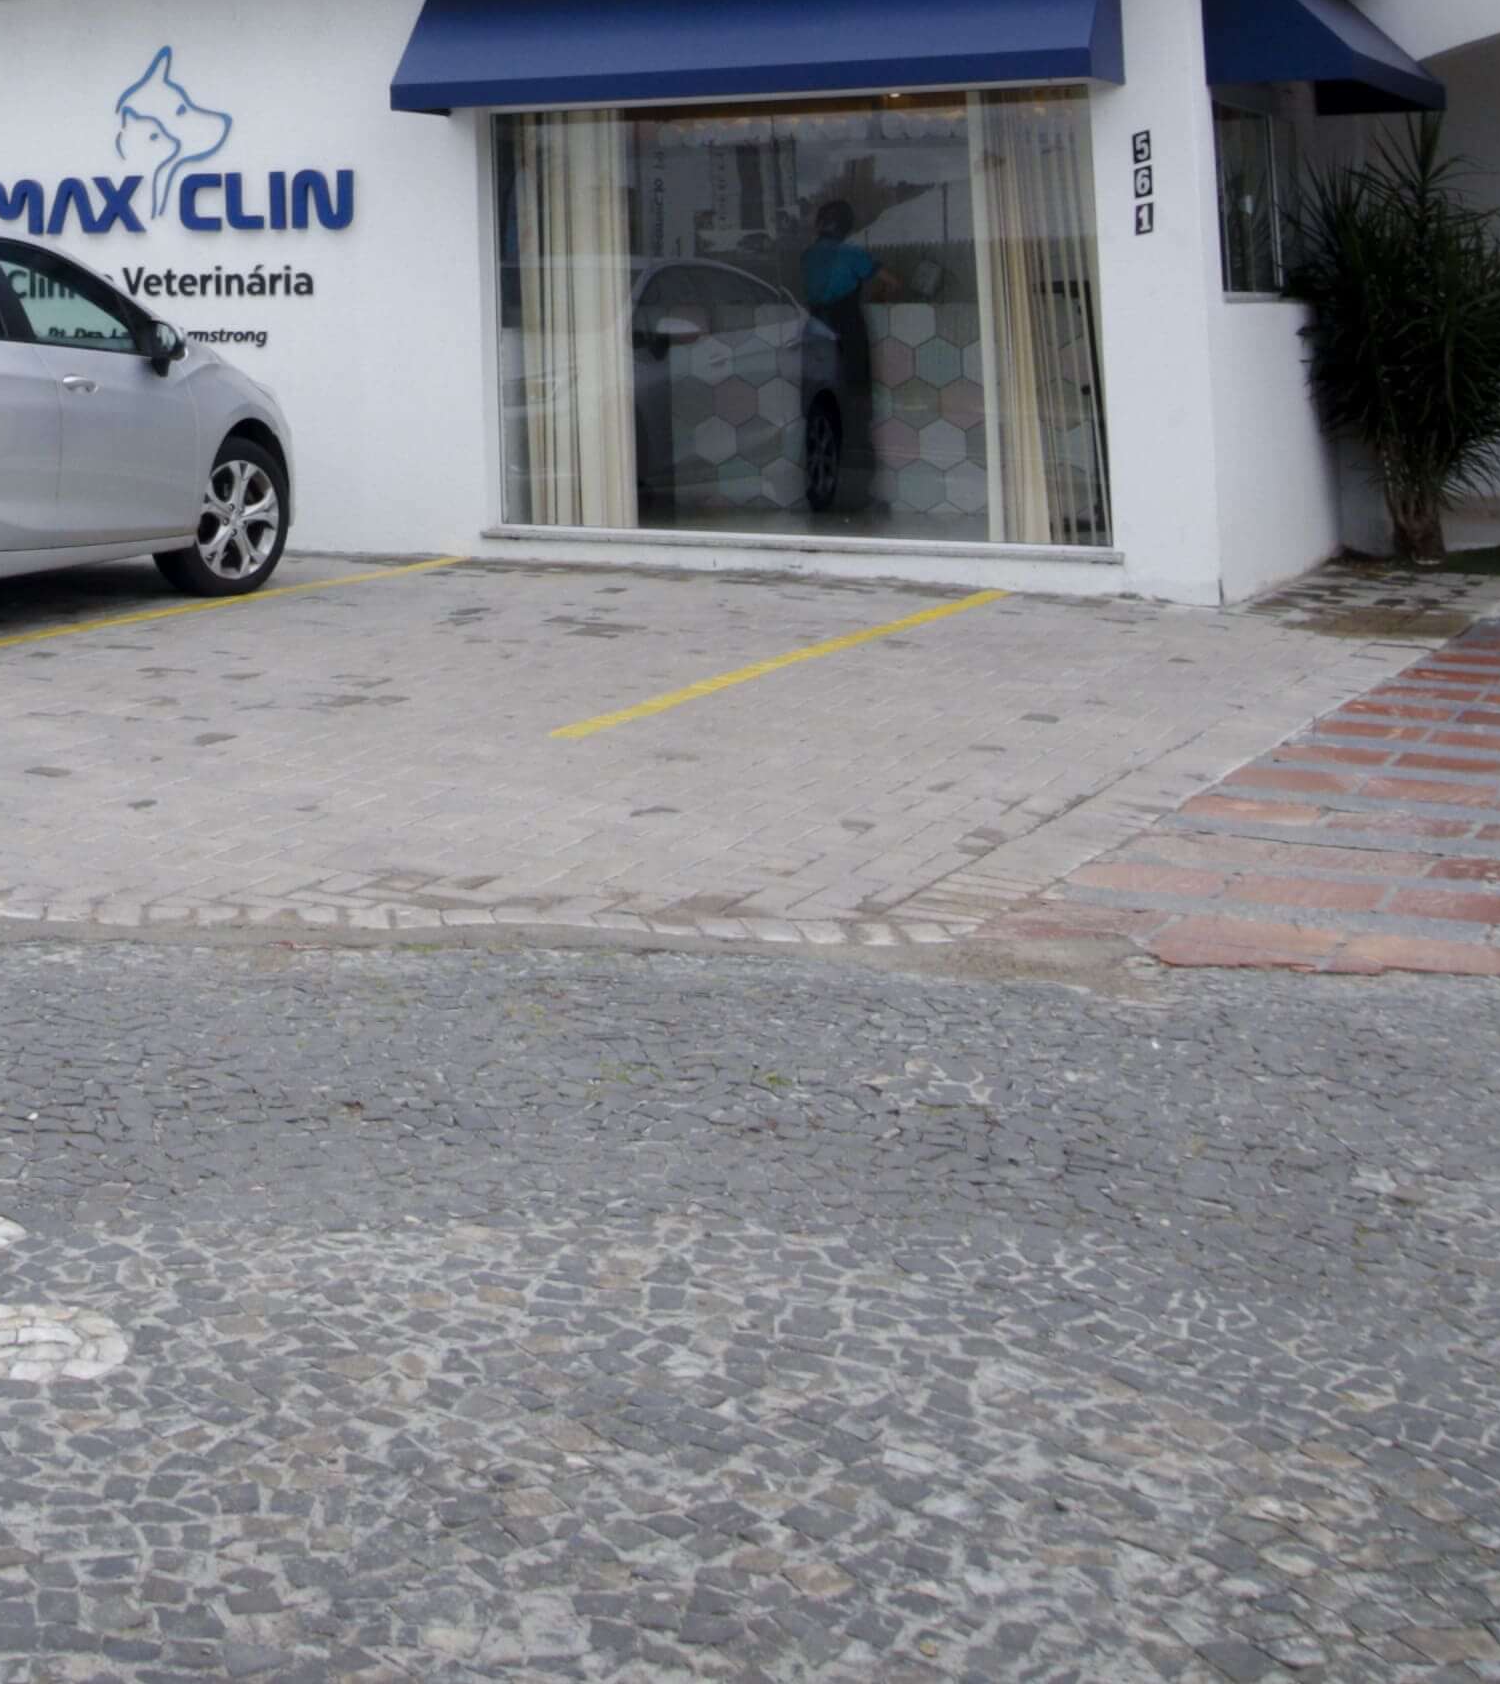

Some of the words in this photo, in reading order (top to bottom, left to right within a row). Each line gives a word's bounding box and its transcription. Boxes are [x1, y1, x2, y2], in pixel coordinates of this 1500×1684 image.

[178, 169, 355, 232] CLIN
[1131, 129, 1154, 236] 561
[122, 264, 315, 298] Veterinária
[186, 327, 268, 349] rmstrong
